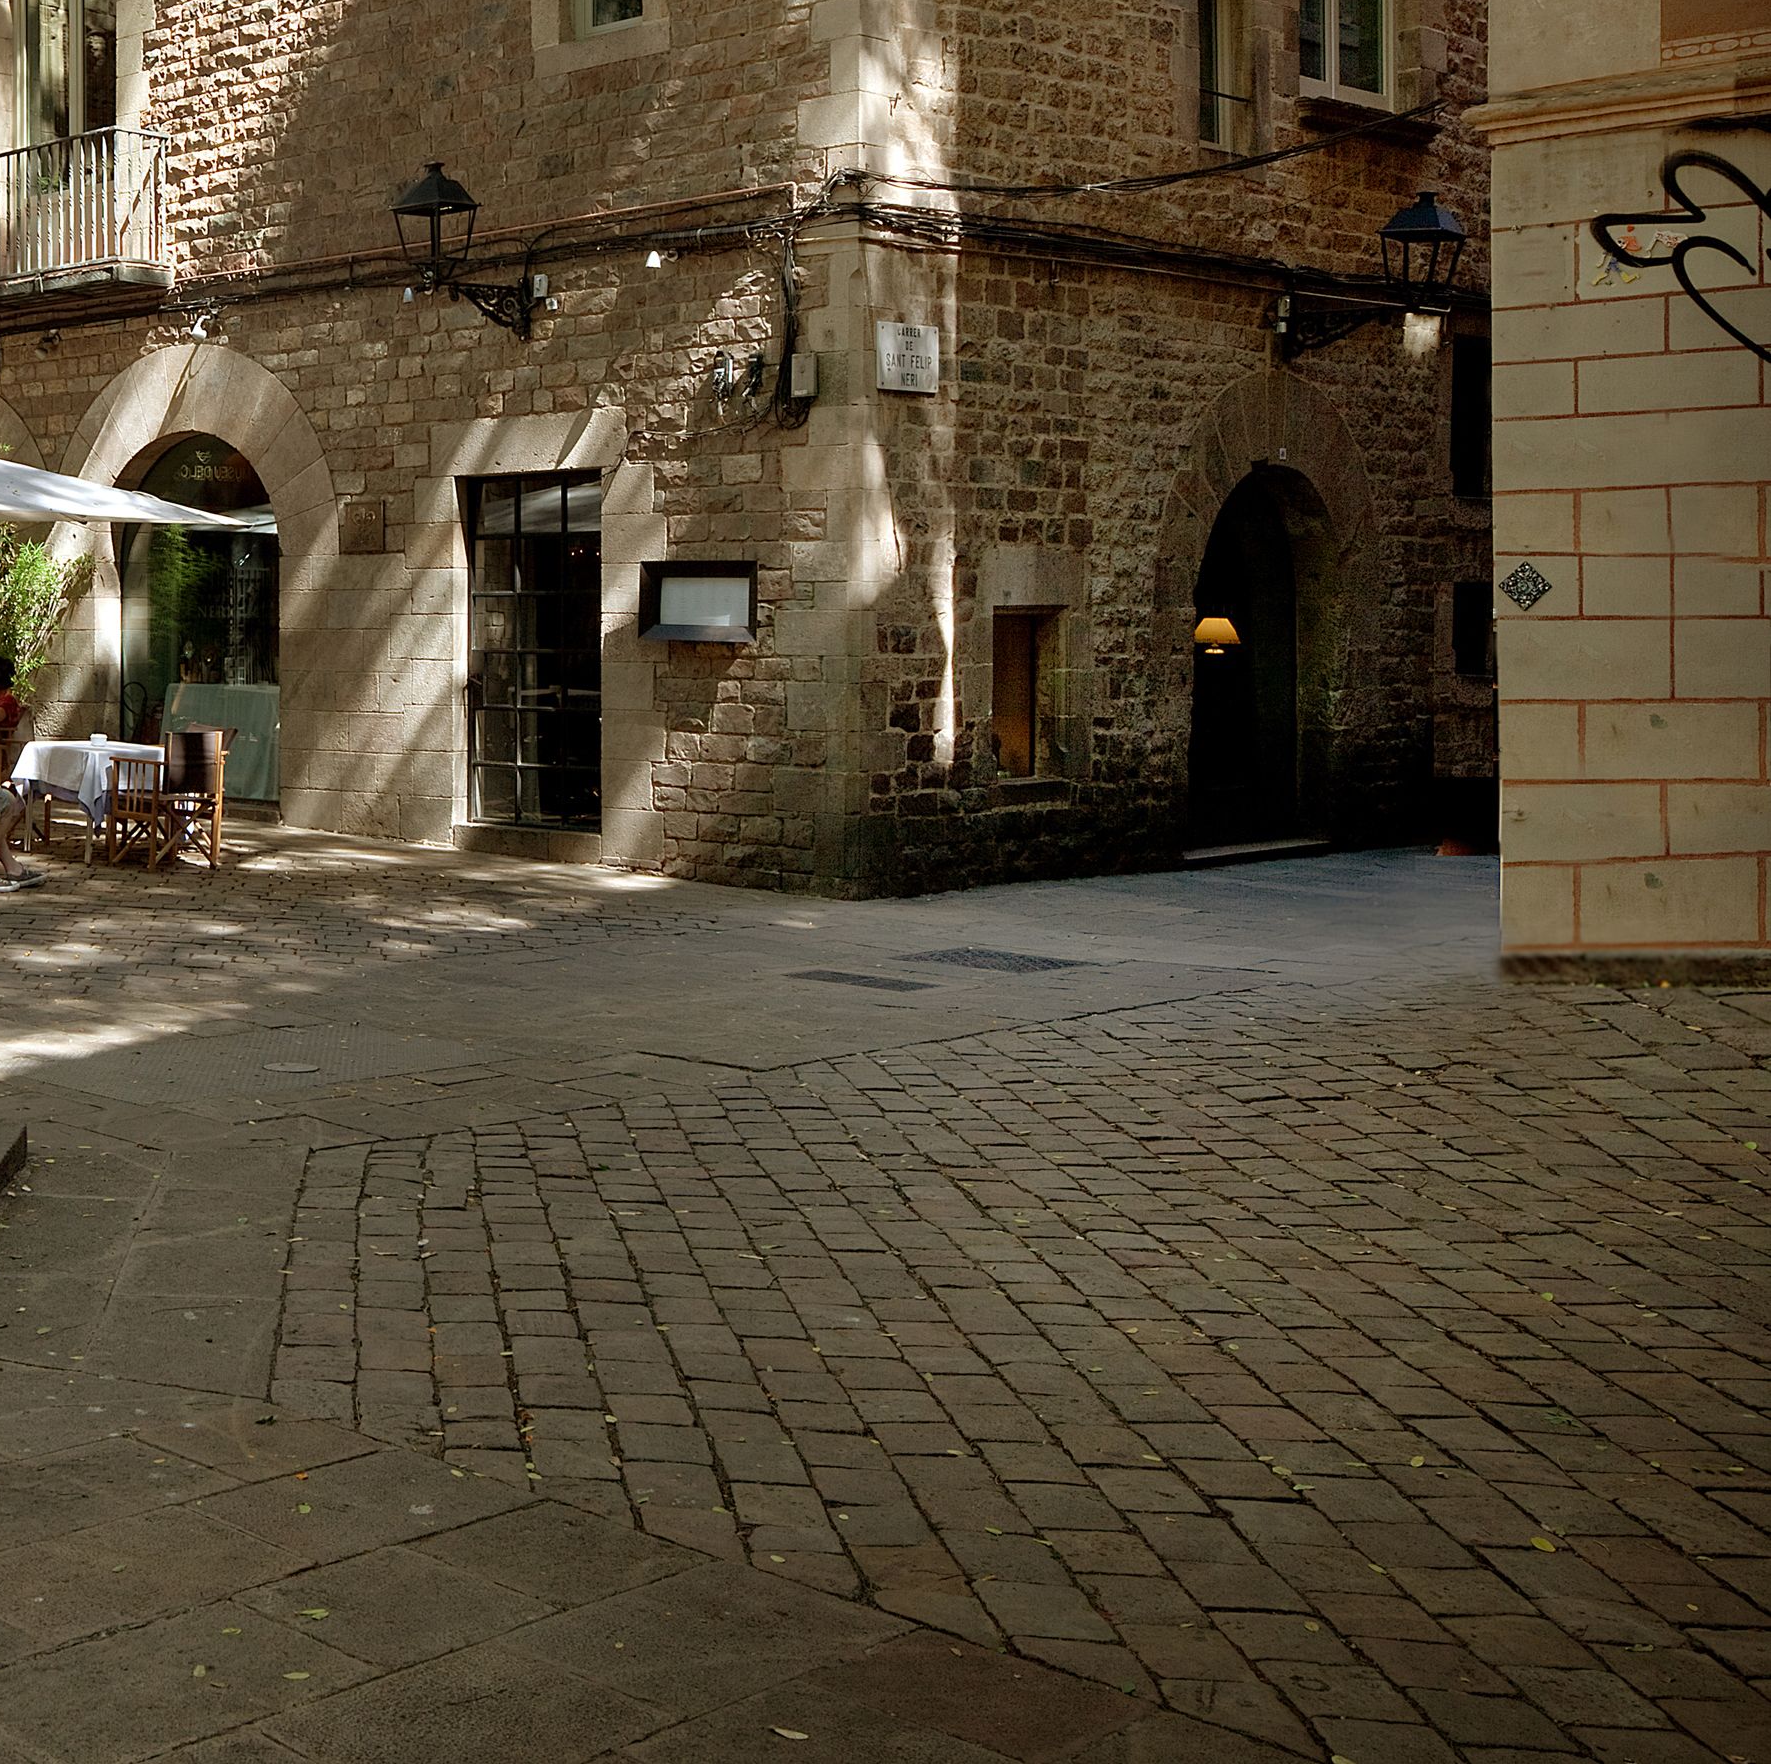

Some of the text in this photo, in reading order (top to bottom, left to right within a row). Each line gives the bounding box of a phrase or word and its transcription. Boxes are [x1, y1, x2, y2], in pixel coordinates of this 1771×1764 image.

[905, 341, 913, 351] DE
[885, 353, 932, 369] SANT FELIP
[901, 373, 917, 387] NERI
